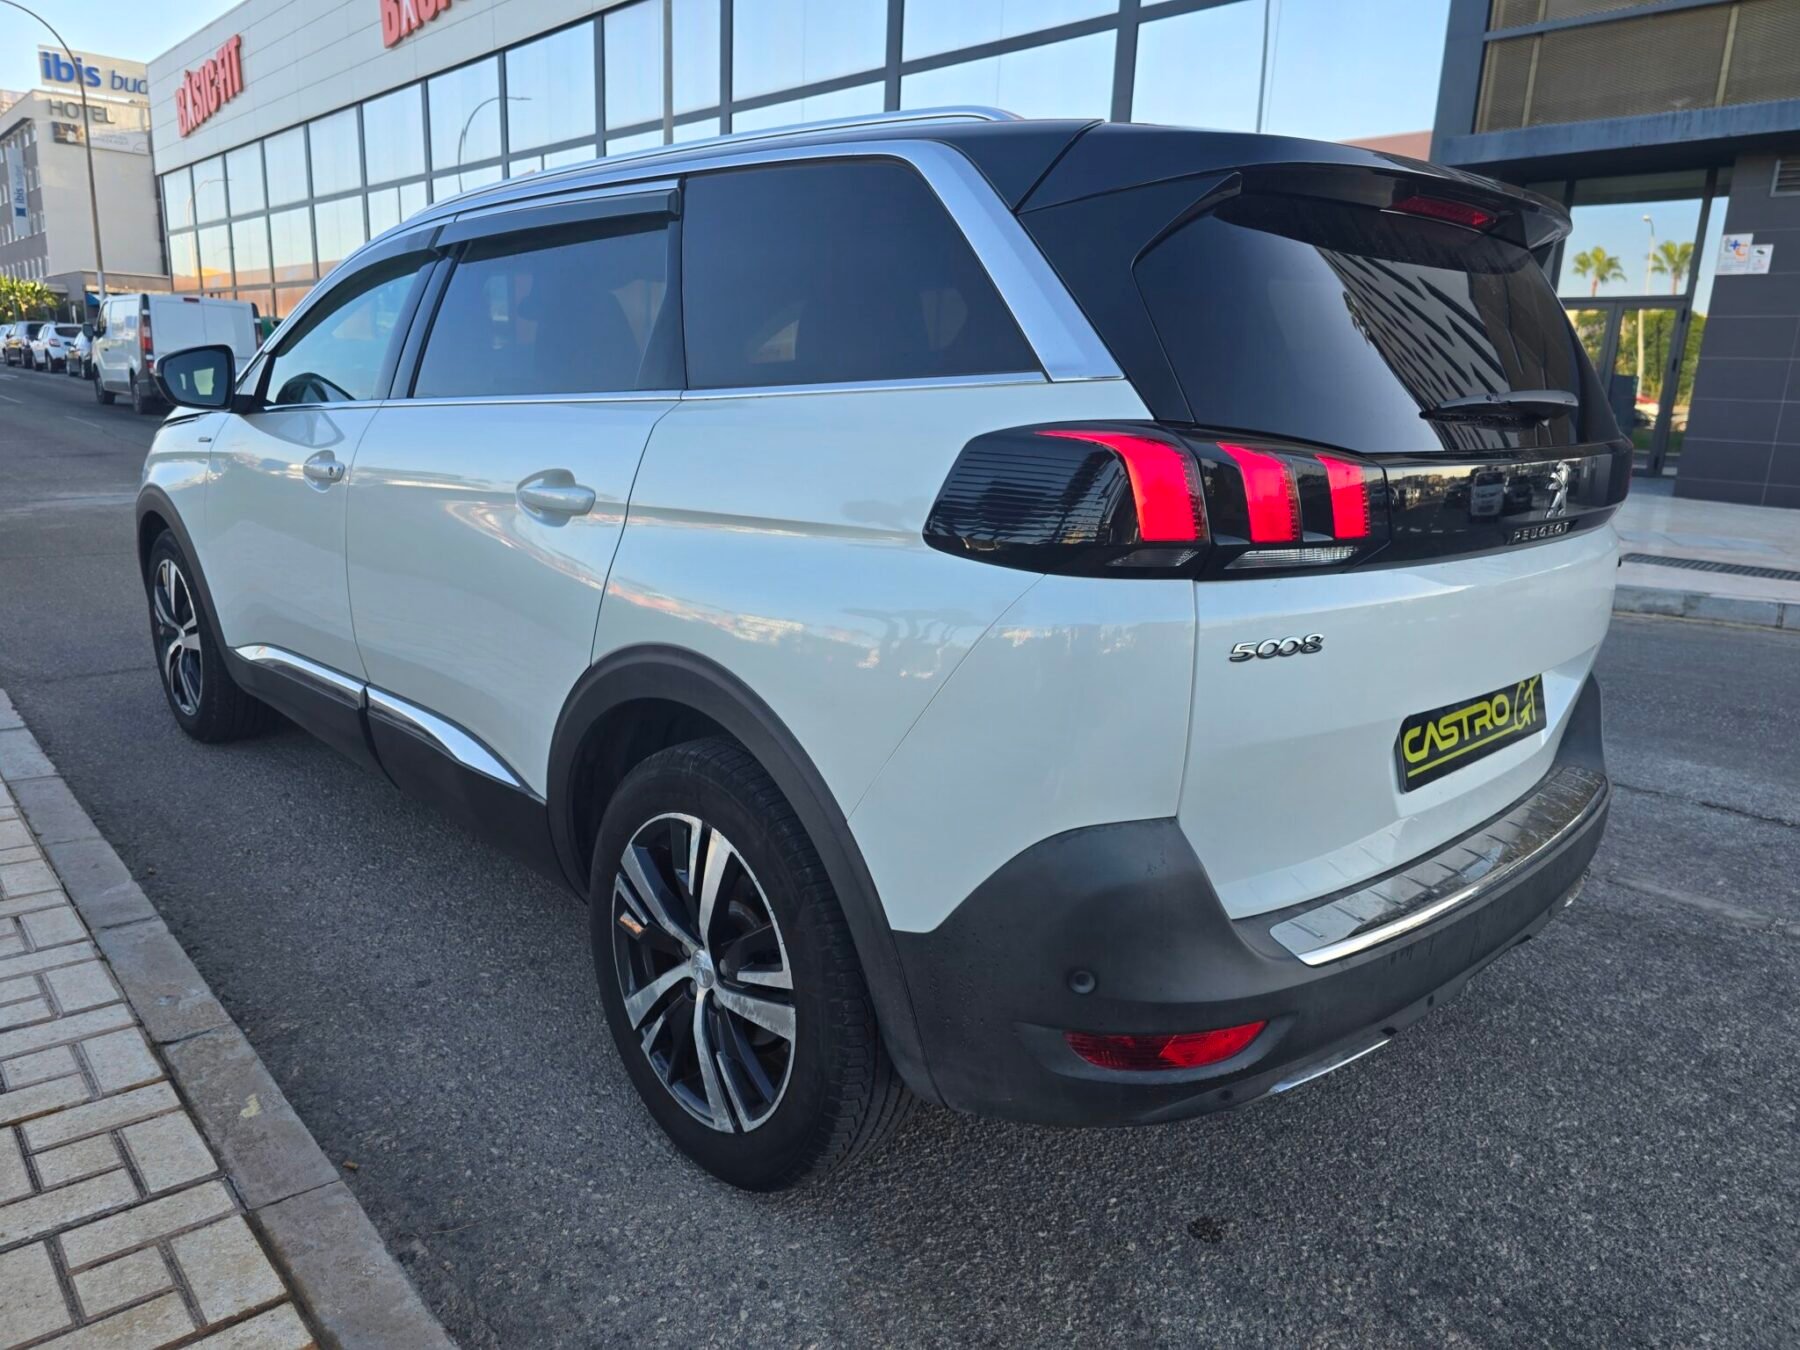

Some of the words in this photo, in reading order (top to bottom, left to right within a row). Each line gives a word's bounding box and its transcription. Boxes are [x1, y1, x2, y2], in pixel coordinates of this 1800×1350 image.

[39, 51, 101, 88] ibis
[1511, 521, 1570, 544] PEUGEOT
[1229, 633, 1325, 663] 5008
[1403, 693, 1510, 763] CASTRO
